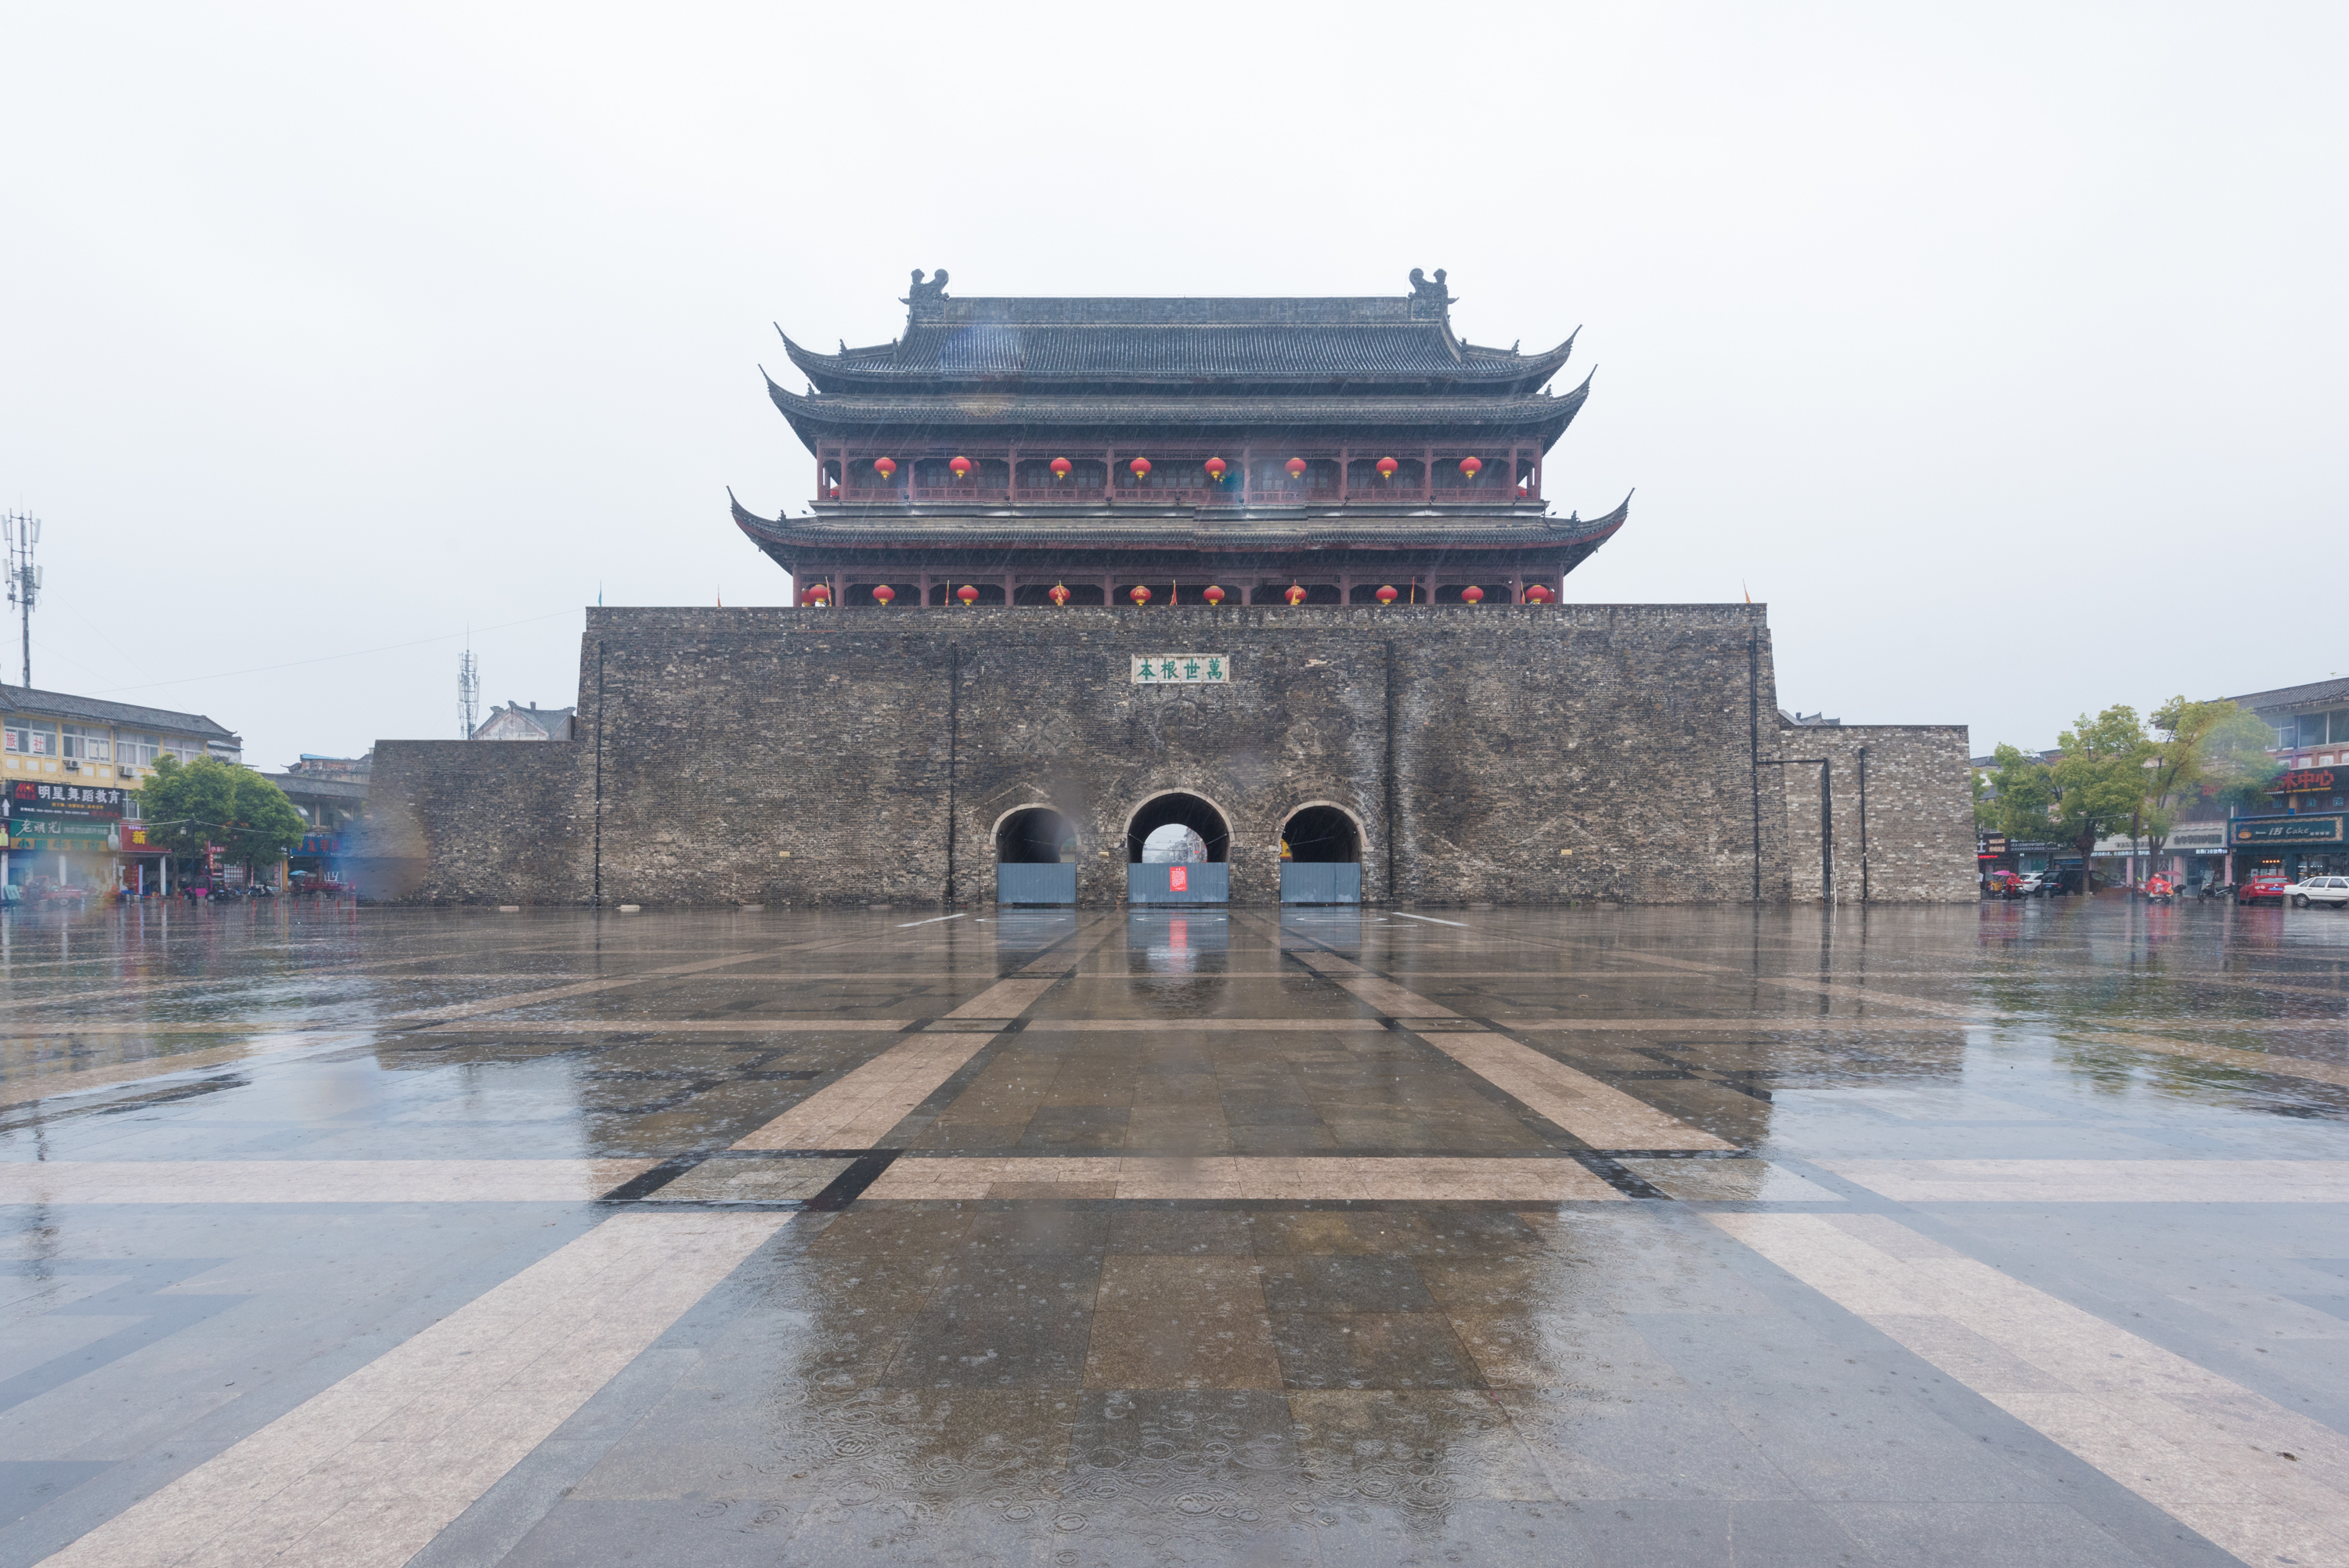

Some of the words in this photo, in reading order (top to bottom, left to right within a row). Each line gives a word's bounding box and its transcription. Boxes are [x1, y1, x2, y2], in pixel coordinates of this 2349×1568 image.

[38, 785, 120, 804] 明星舞蹈教育
[16, 819, 61, 837] 老明光
[2286, 827, 2309, 837] Cake
[132, 831, 146, 844] 新
